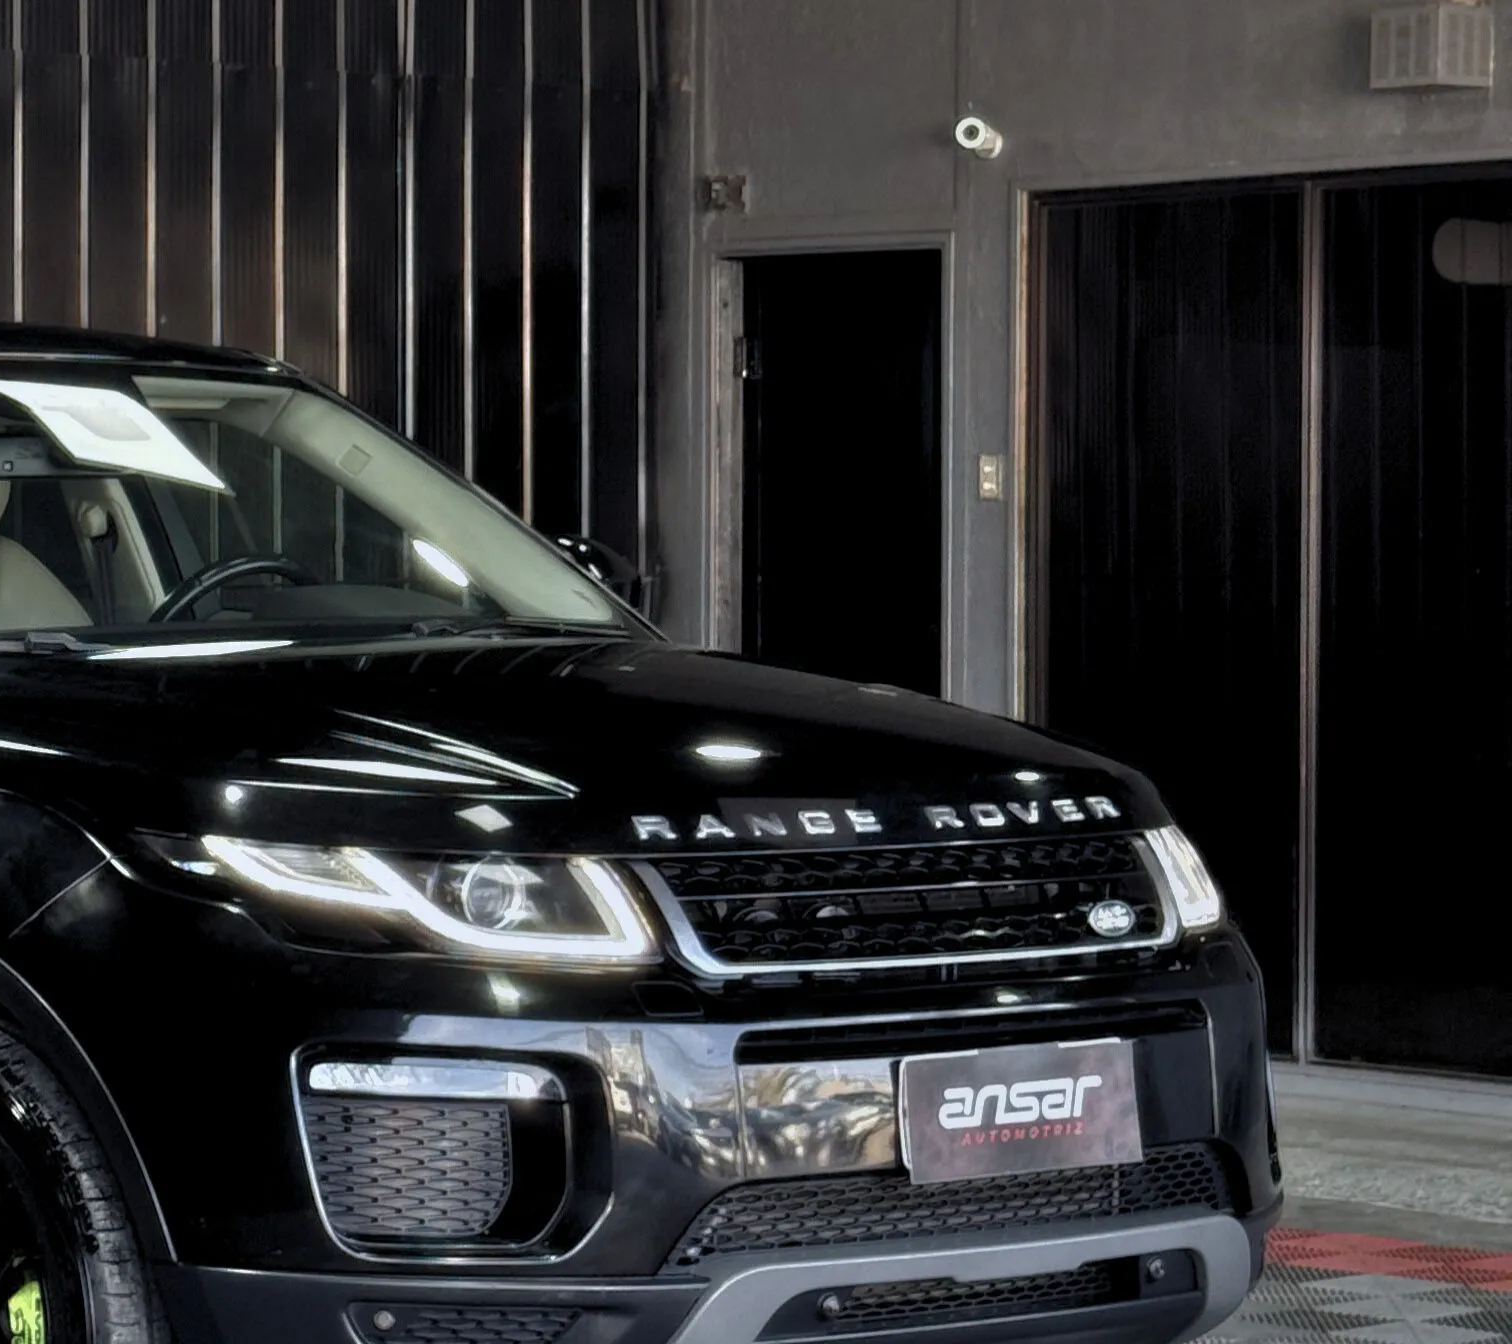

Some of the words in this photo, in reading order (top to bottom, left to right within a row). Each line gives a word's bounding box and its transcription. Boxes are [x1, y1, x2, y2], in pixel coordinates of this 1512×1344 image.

[630, 808, 882, 842] RANGE
[925, 794, 1122, 830] ROVER
[938, 1074, 1103, 1130] ansar
[960, 1120, 1085, 1146] AUTOMOTRIZ
